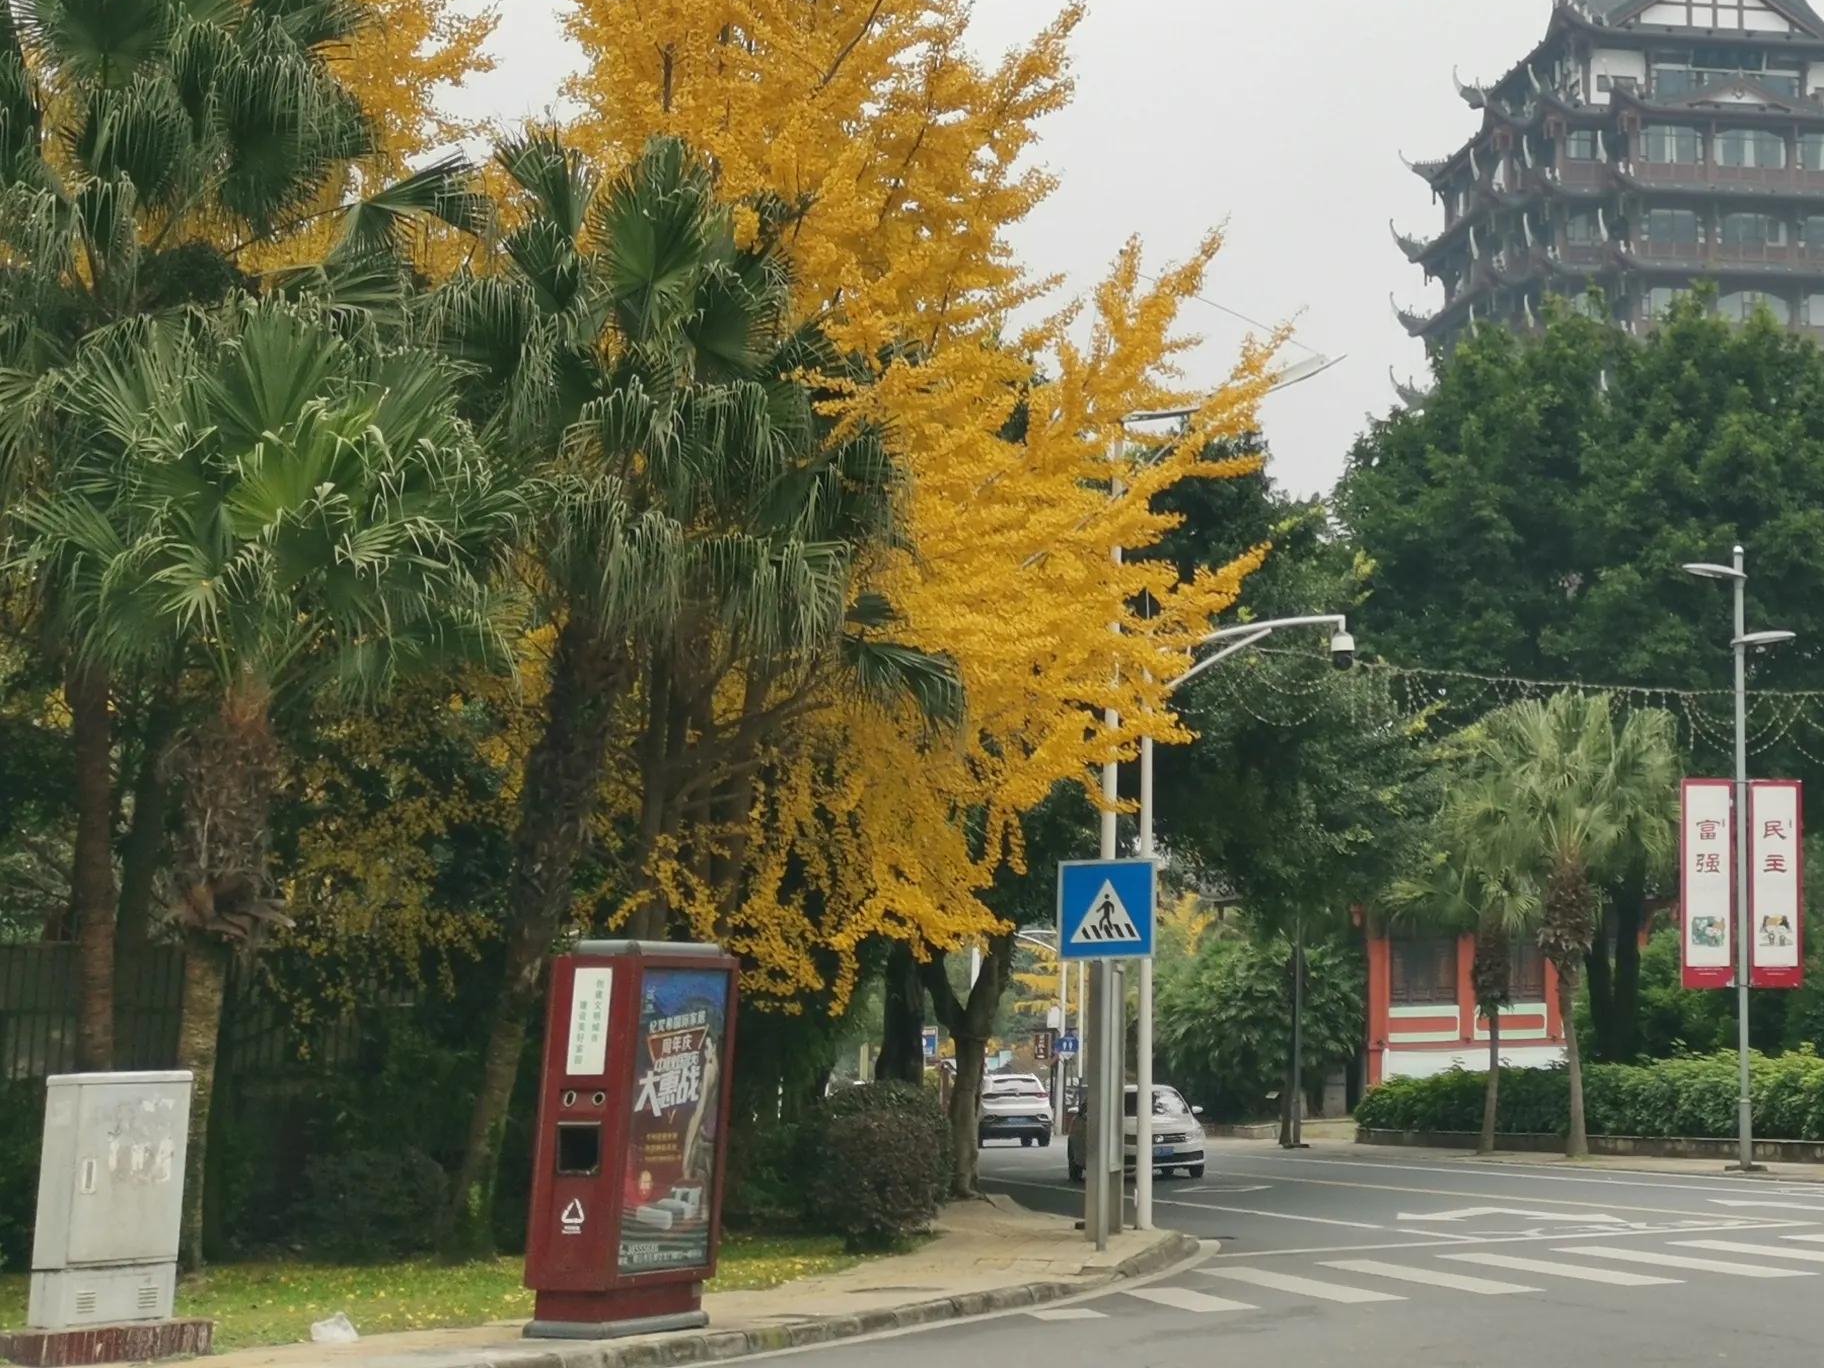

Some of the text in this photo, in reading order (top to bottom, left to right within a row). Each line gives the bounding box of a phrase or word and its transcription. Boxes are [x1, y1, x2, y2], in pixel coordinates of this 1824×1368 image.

[1696, 819, 1721, 873] 富强
[1763, 820, 1788, 873] 民主
[661, 1034, 693, 1056] 周年庆
[634, 1066, 700, 1118] 大惠战
